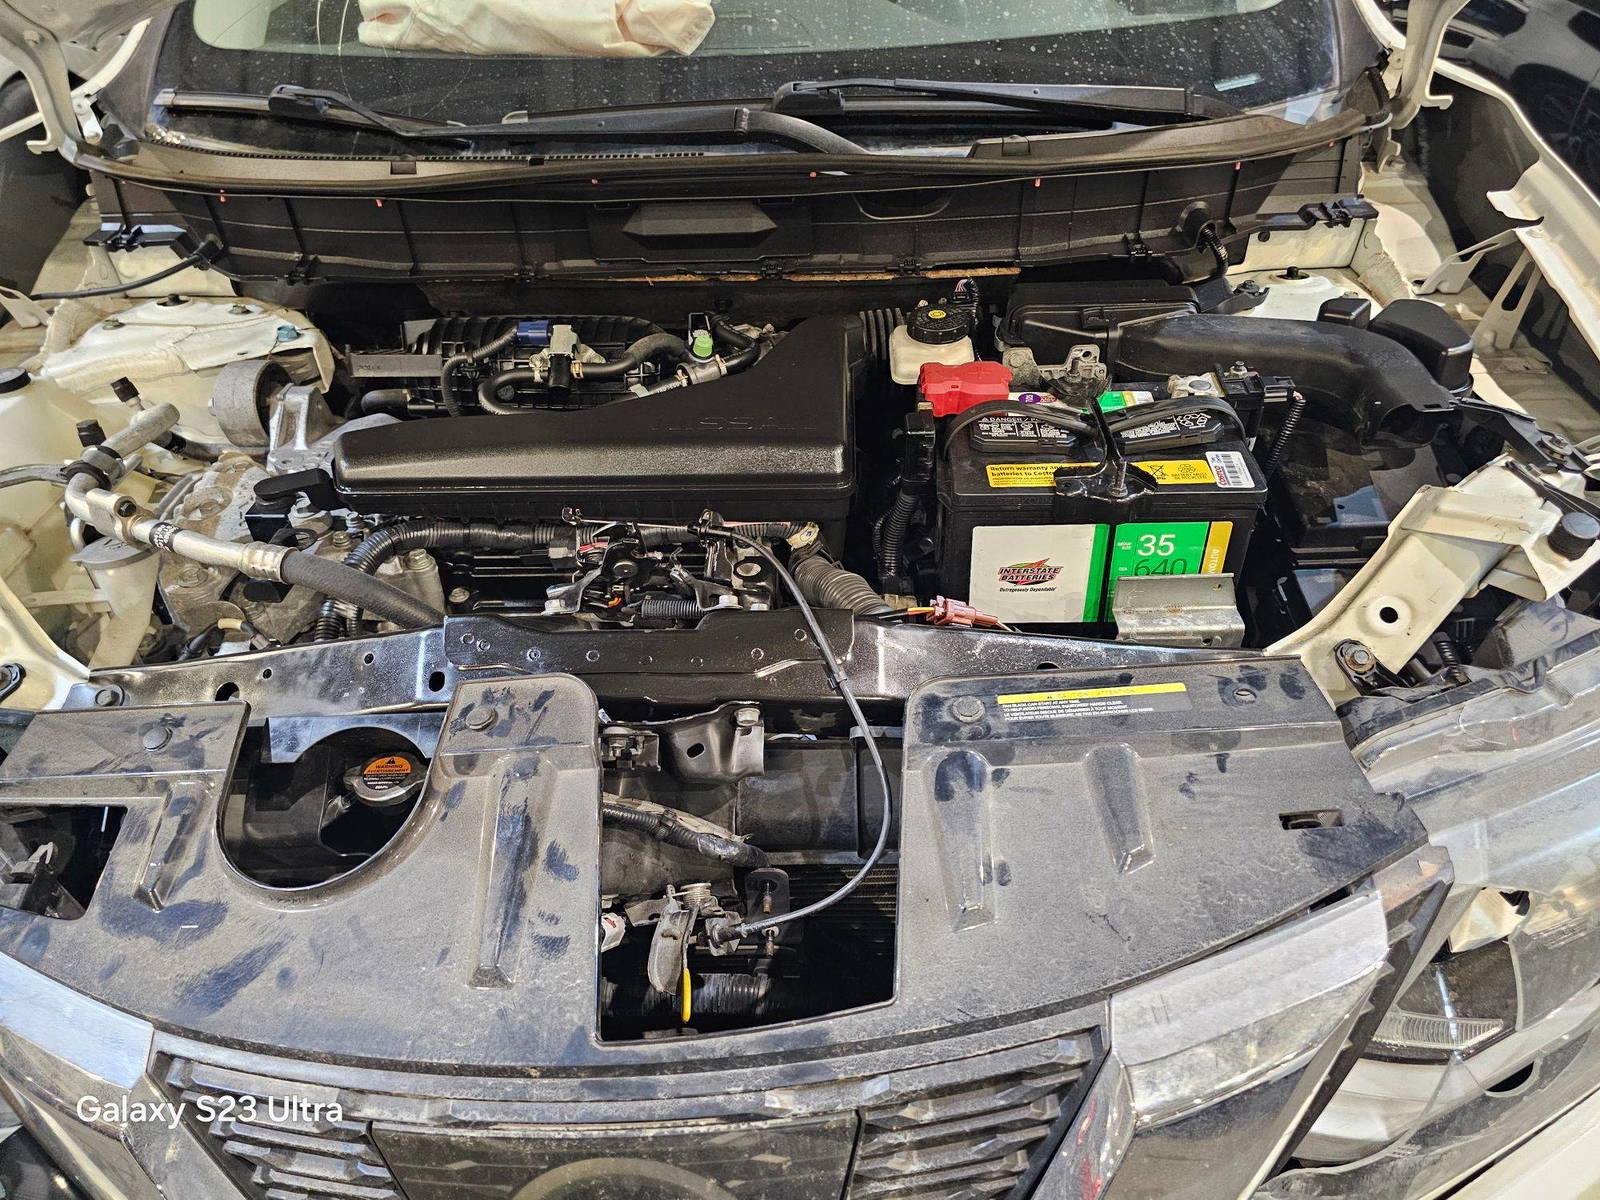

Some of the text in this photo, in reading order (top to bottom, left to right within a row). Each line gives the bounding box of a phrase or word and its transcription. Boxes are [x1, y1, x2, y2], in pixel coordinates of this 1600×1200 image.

[1214, 465, 1228, 486] COSTCO
[1137, 533, 1176, 557] 35
[1134, 558, 1188, 576] 640
